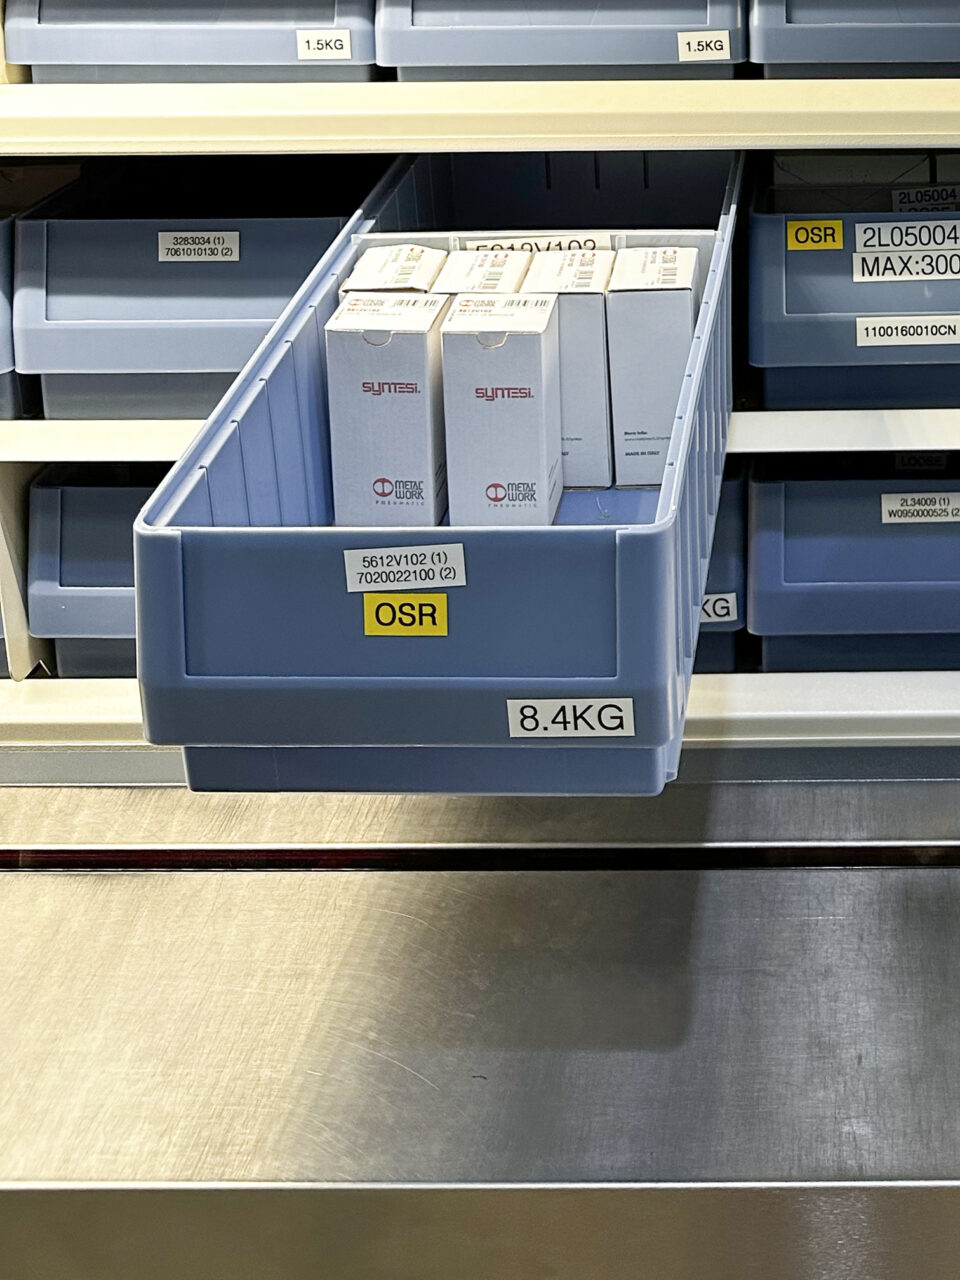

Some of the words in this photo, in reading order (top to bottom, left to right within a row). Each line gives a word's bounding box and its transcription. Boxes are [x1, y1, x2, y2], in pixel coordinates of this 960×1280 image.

[305, 38, 344, 51] 1.5KG
[685, 39, 724, 53] 1.5KG
[898, 189, 957, 203] 2L05004
[172, 236, 211, 246] 3283034
[212, 235, 225, 246] (1)
[794, 226, 837, 244] OSR
[862, 224, 960, 248] 2L05004
[164, 246, 219, 257] 7061010130
[220, 246, 234, 257] (2)
[864, 324, 957, 338] 1100160010CN
[395, 480, 424, 490] METAL
[508, 483, 536, 492] METAL
[395, 490, 424, 500] WORK
[508, 492, 536, 502] WORK
[899, 496, 936, 507] 2L34009
[938, 495, 951, 507] (1)
[887, 507, 950, 519] W0950000525
[363, 554, 427, 568] 5612V102
[431, 552, 448, 565] (1)
[356, 567, 436, 585] 7020022100
[439, 566, 457, 582] (2)
[374, 602, 438, 627] OSR
[519, 703, 625, 732] 8.4KG
